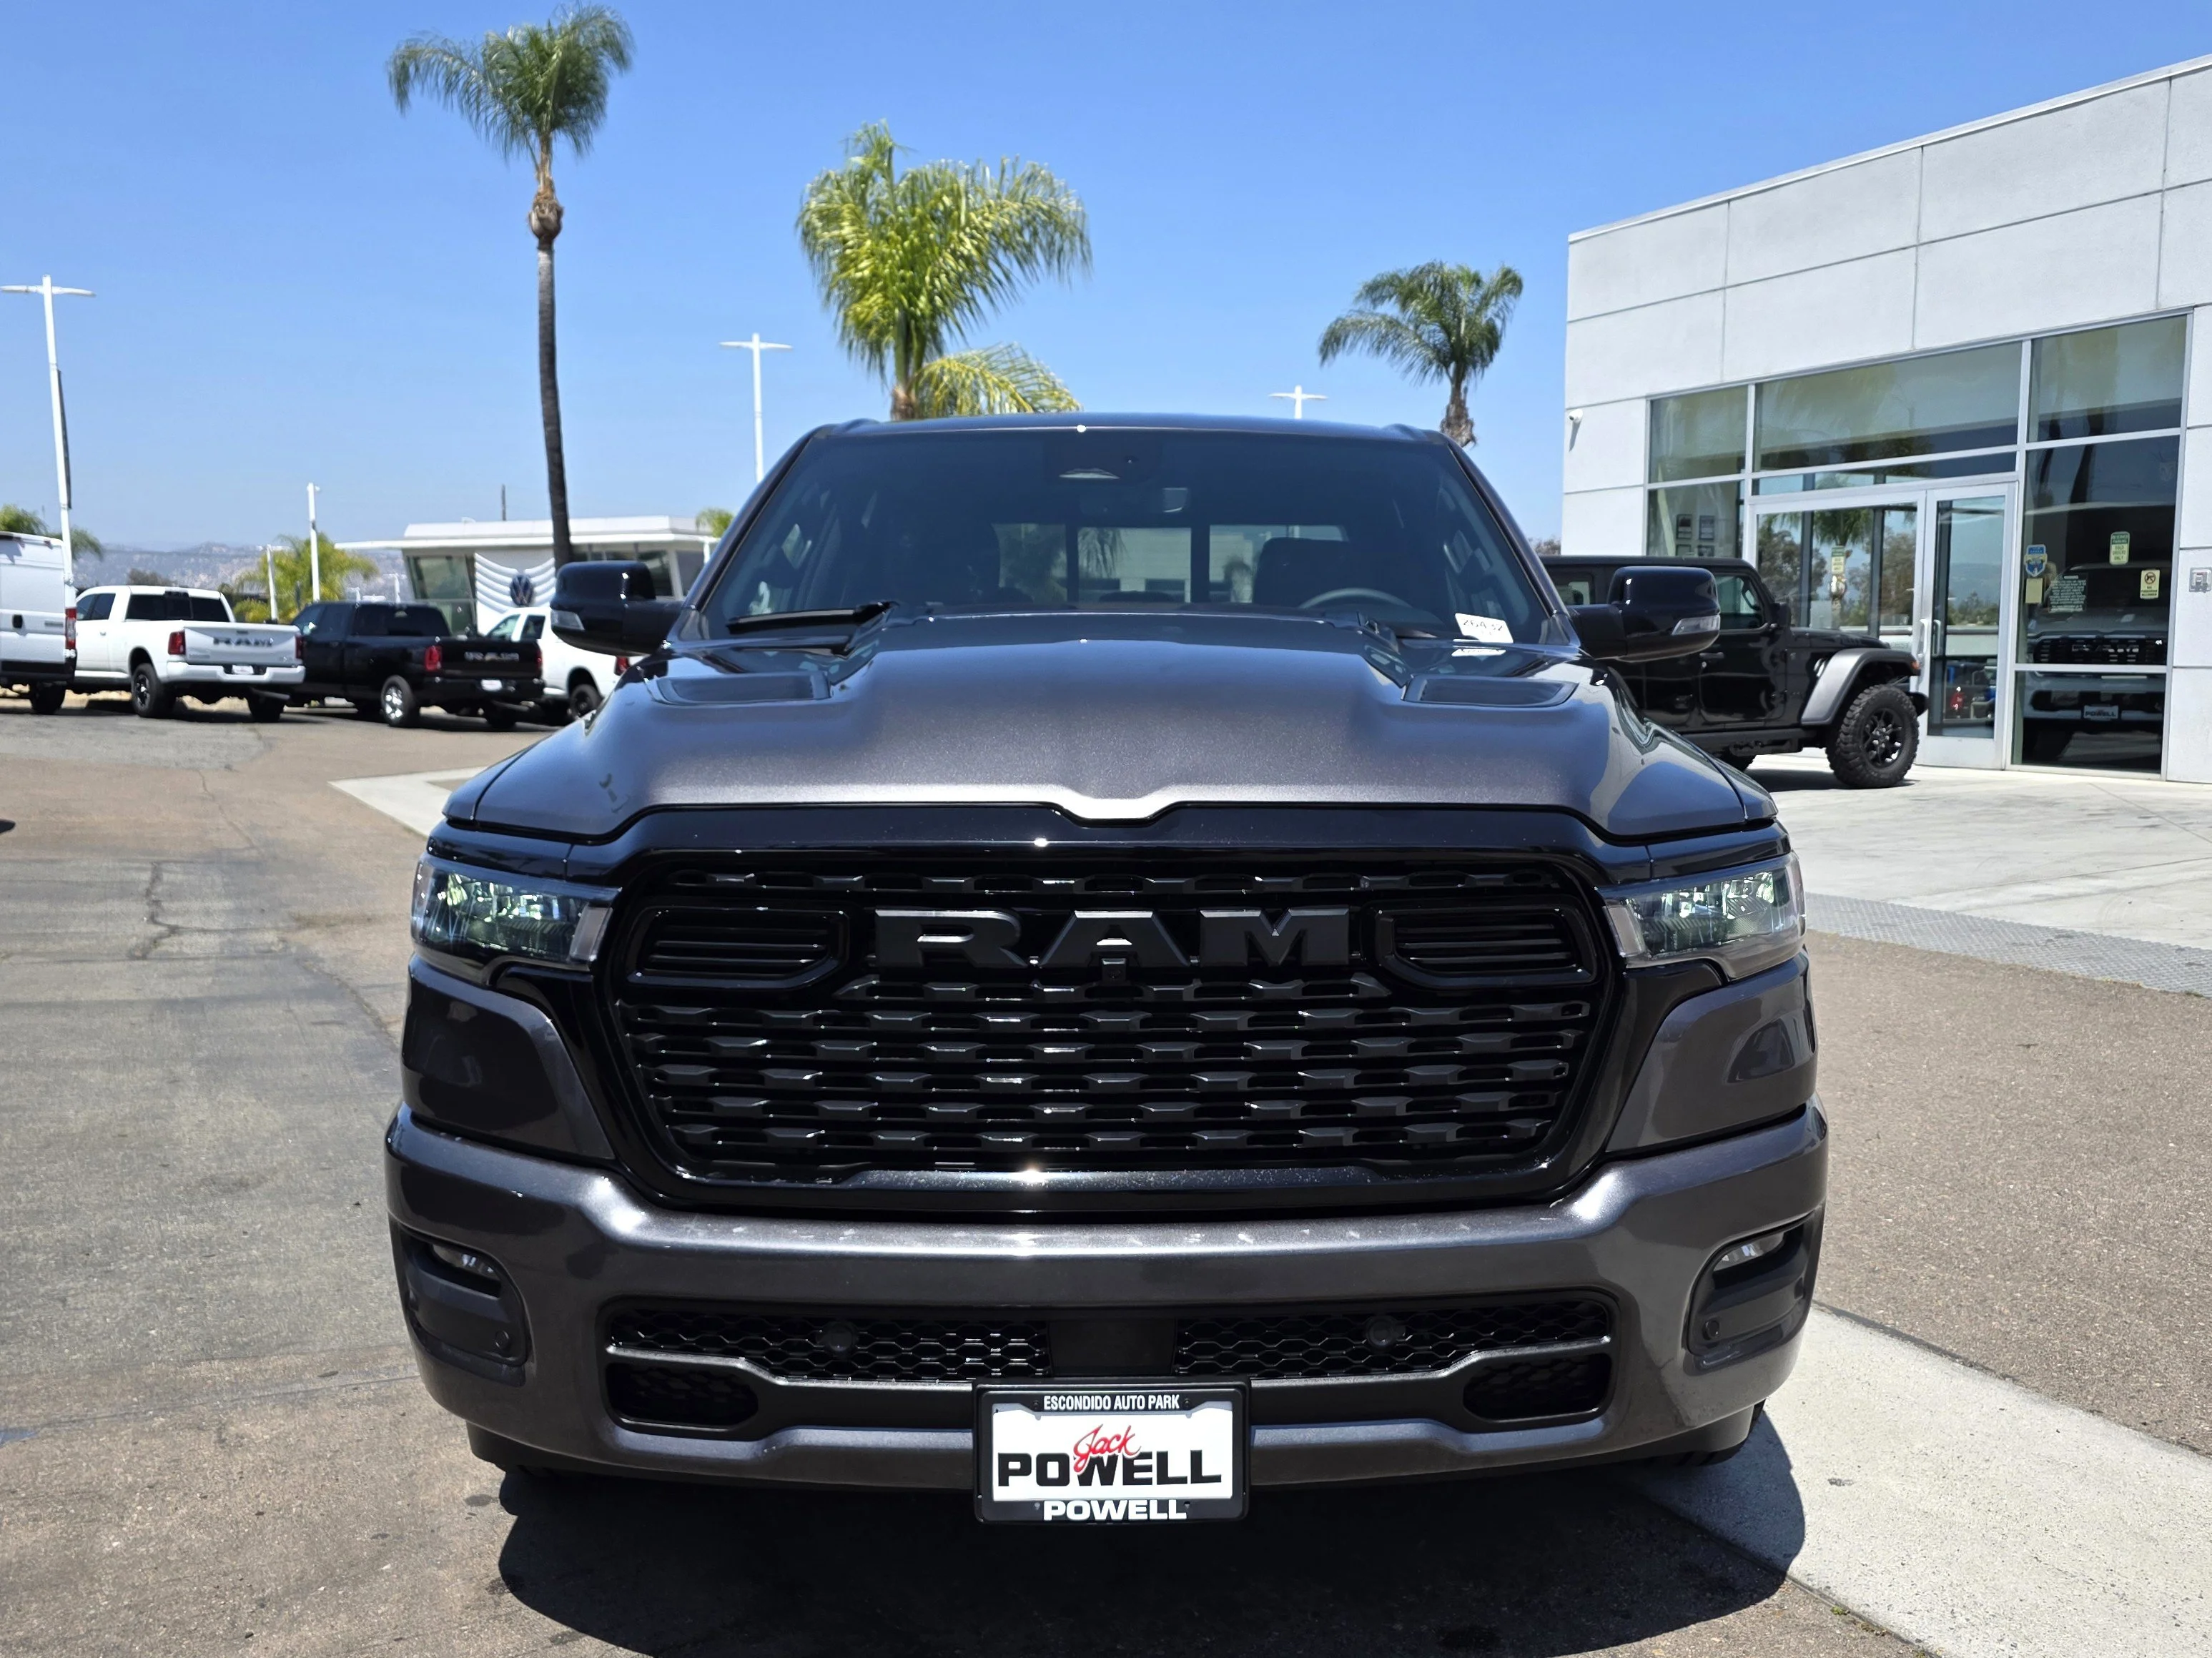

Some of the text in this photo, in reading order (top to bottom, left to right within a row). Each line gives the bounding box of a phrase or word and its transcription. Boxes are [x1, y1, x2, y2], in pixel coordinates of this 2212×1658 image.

[876, 908, 1349, 967] RAM
[1043, 1394, 1180, 1411] ESCONDIDO AUTO PARK
[1073, 1423, 1142, 1474] Jack
[998, 1449, 1222, 1487] POWELL
[1043, 1499, 1188, 1521] POWELL
